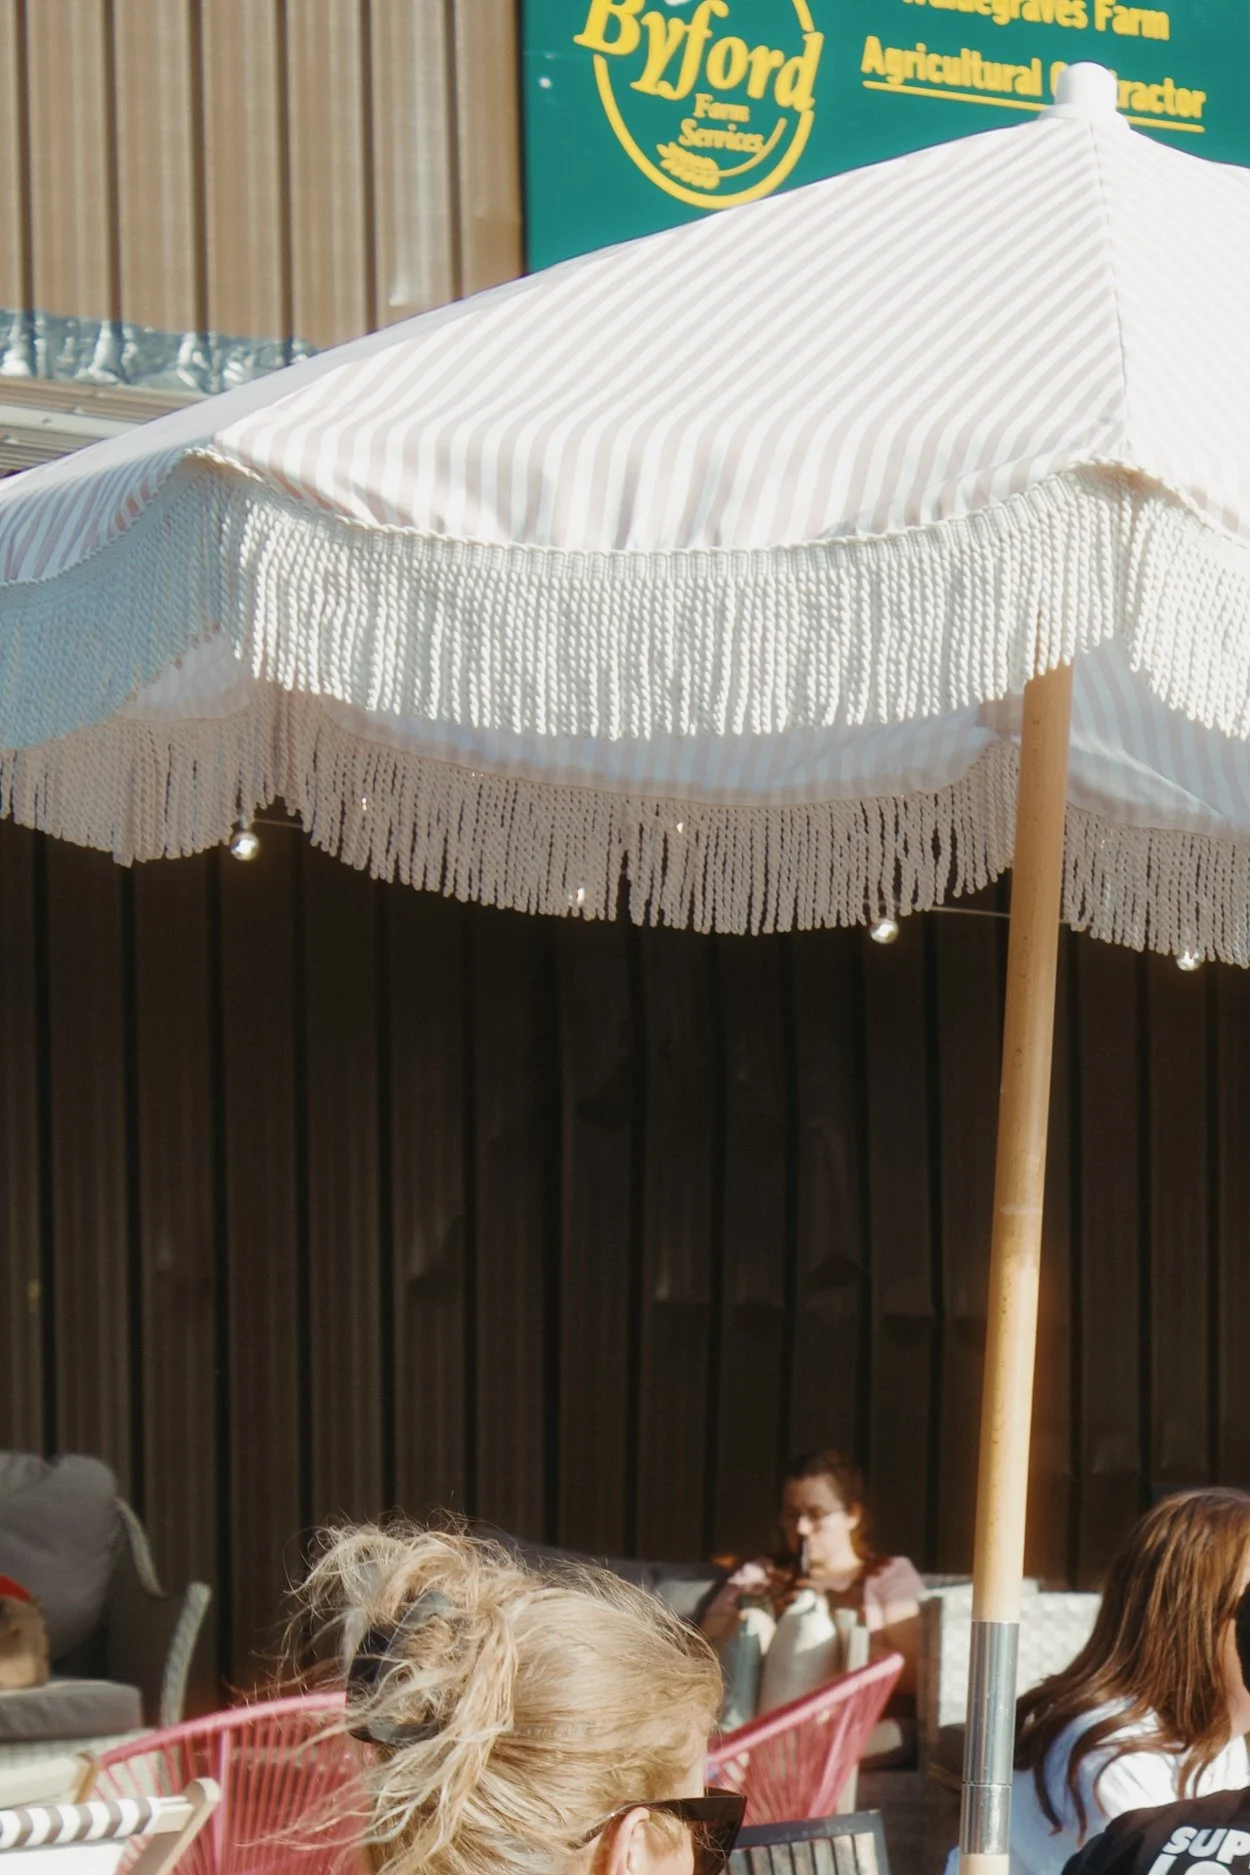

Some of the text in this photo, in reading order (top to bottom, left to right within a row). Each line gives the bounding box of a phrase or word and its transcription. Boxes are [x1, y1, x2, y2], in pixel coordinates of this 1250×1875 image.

[1094, 0, 1170, 40] Farm
[573, 0, 824, 112] Byford
[860, 35, 1042, 97] Agricultural
[693, 93, 749, 122] Farm
[678, 118, 765, 153] Services
